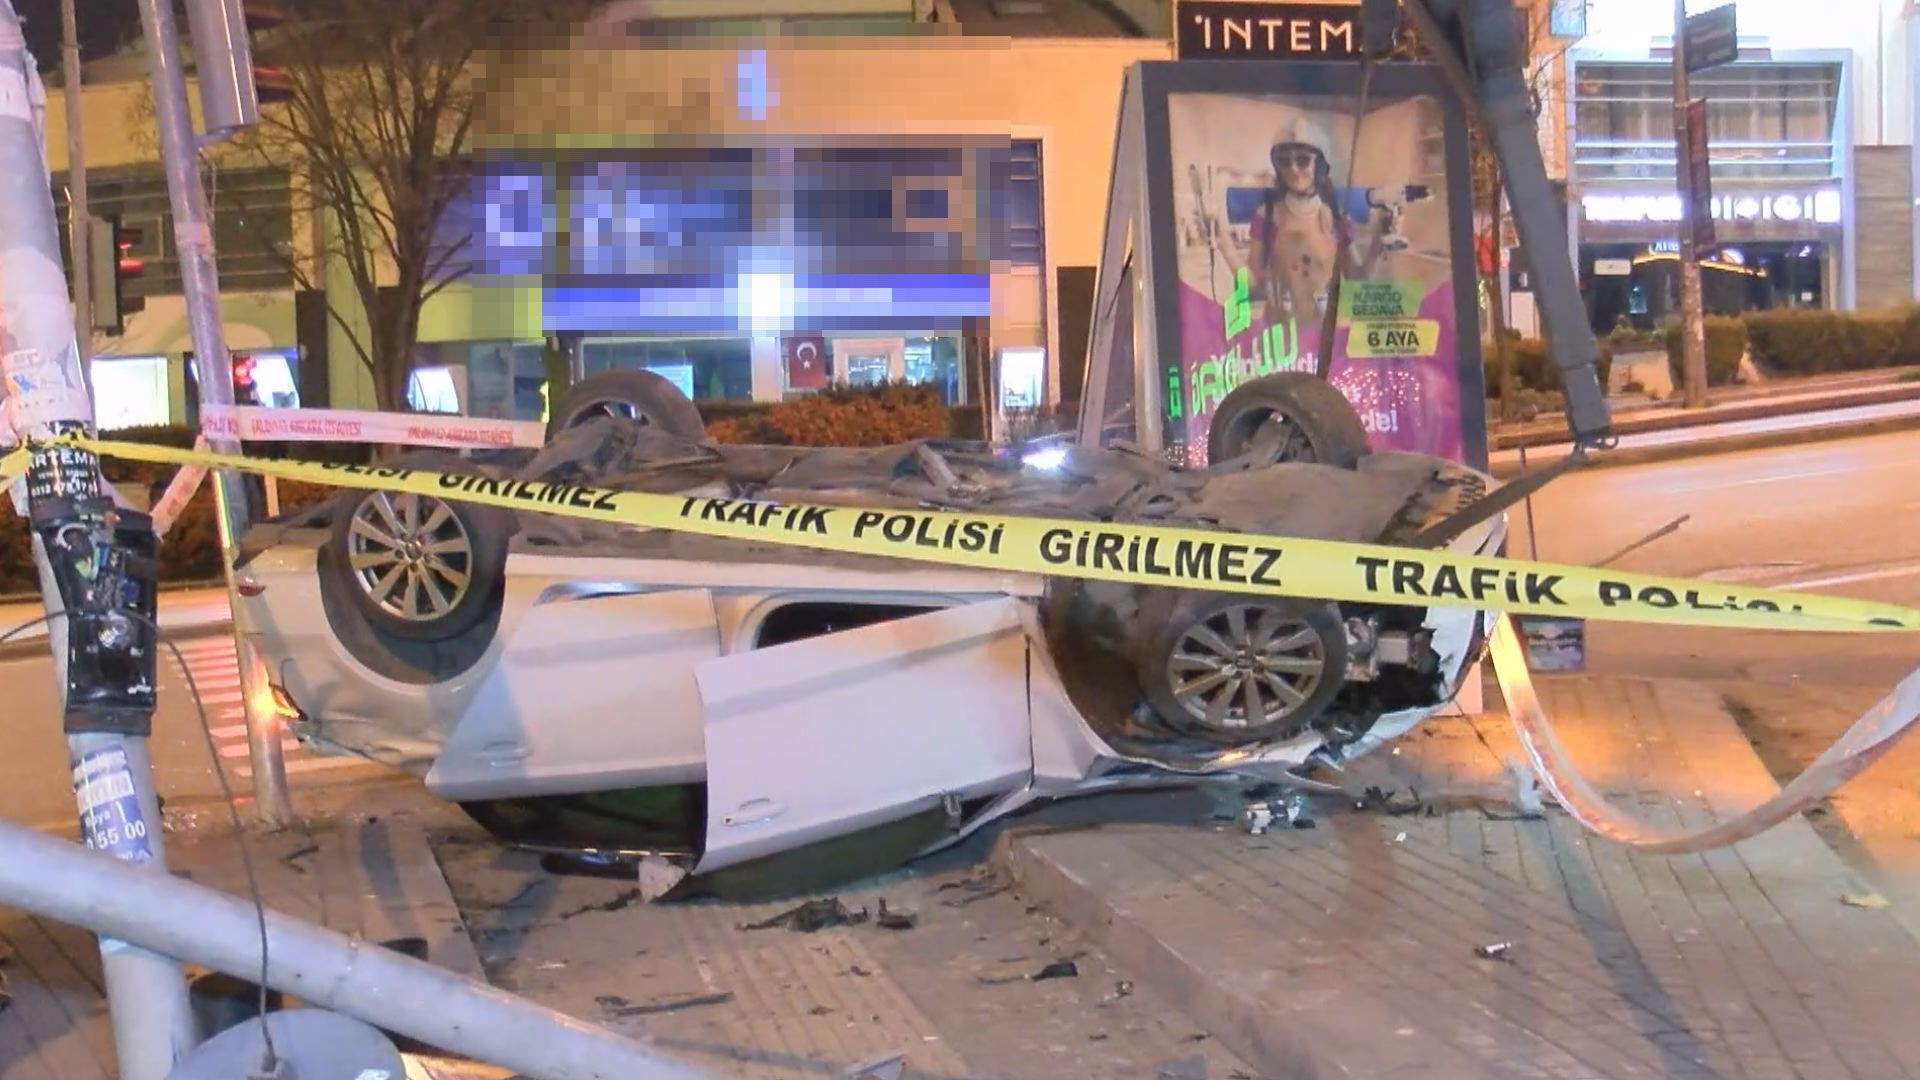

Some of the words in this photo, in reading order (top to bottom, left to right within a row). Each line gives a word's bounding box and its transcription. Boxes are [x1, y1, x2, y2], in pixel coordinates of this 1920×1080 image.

[1195, 15, 1364, 53] İNTEM
[1367, 331, 1381, 347] 6
[1385, 331, 1420, 347] AYA
[30, 448, 97, 470] RTEM
[97, 828, 119, 849] 55
[124, 820, 146, 839] 00
